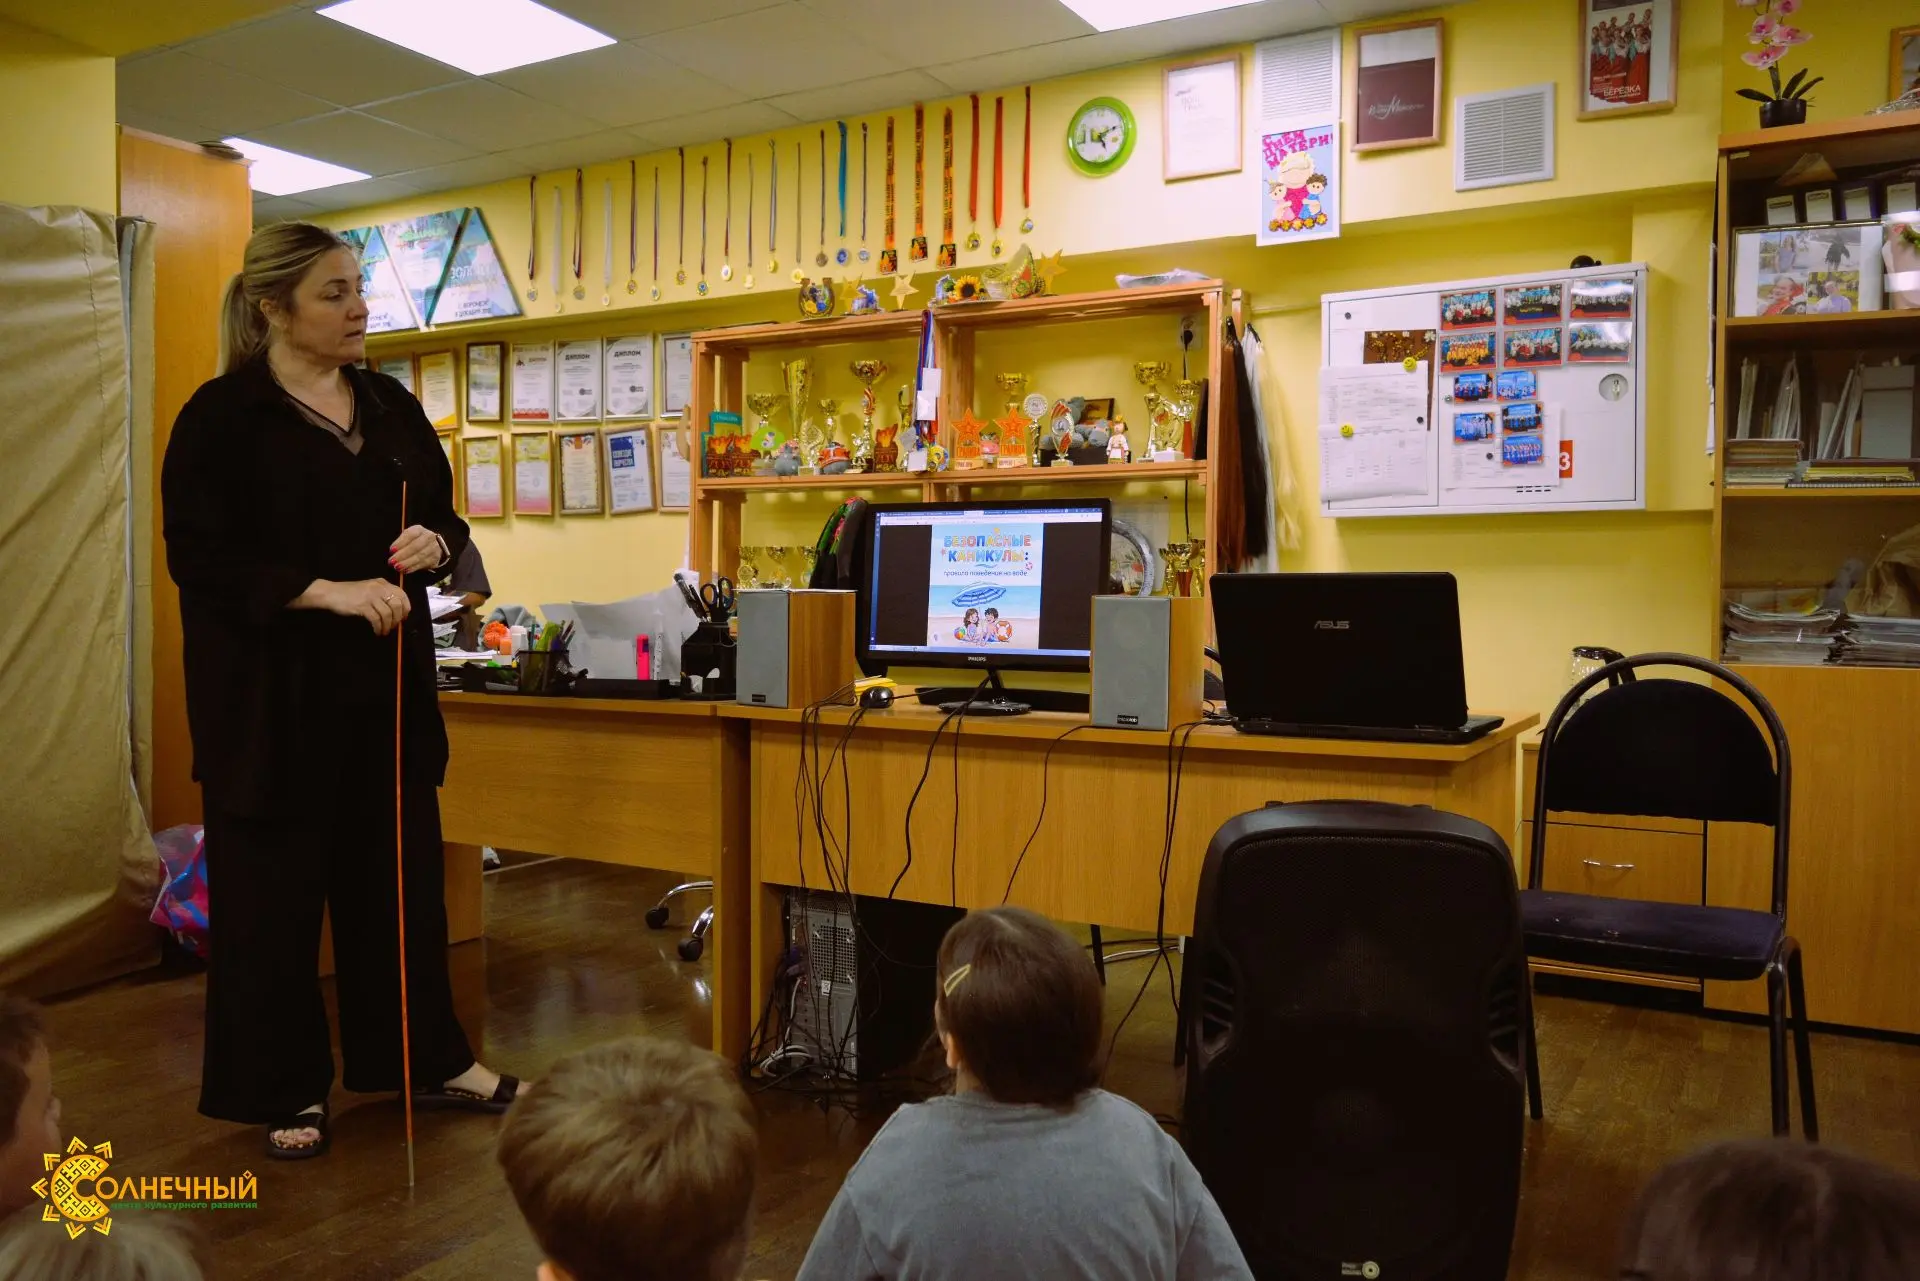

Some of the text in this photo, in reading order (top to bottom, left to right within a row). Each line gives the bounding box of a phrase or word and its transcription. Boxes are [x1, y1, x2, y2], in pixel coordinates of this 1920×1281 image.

[565, 353, 591, 361] ДИПЛОМ
[614, 350, 642, 358] ДИПЛОМ
[1559, 451, 1571, 471] 3
[943, 535, 1032, 548] БЕЗОПАСНЫЕ
[948, 549, 1029, 562] КАНИКУЛЫ:
[1313, 620, 1350, 630] ASUS
